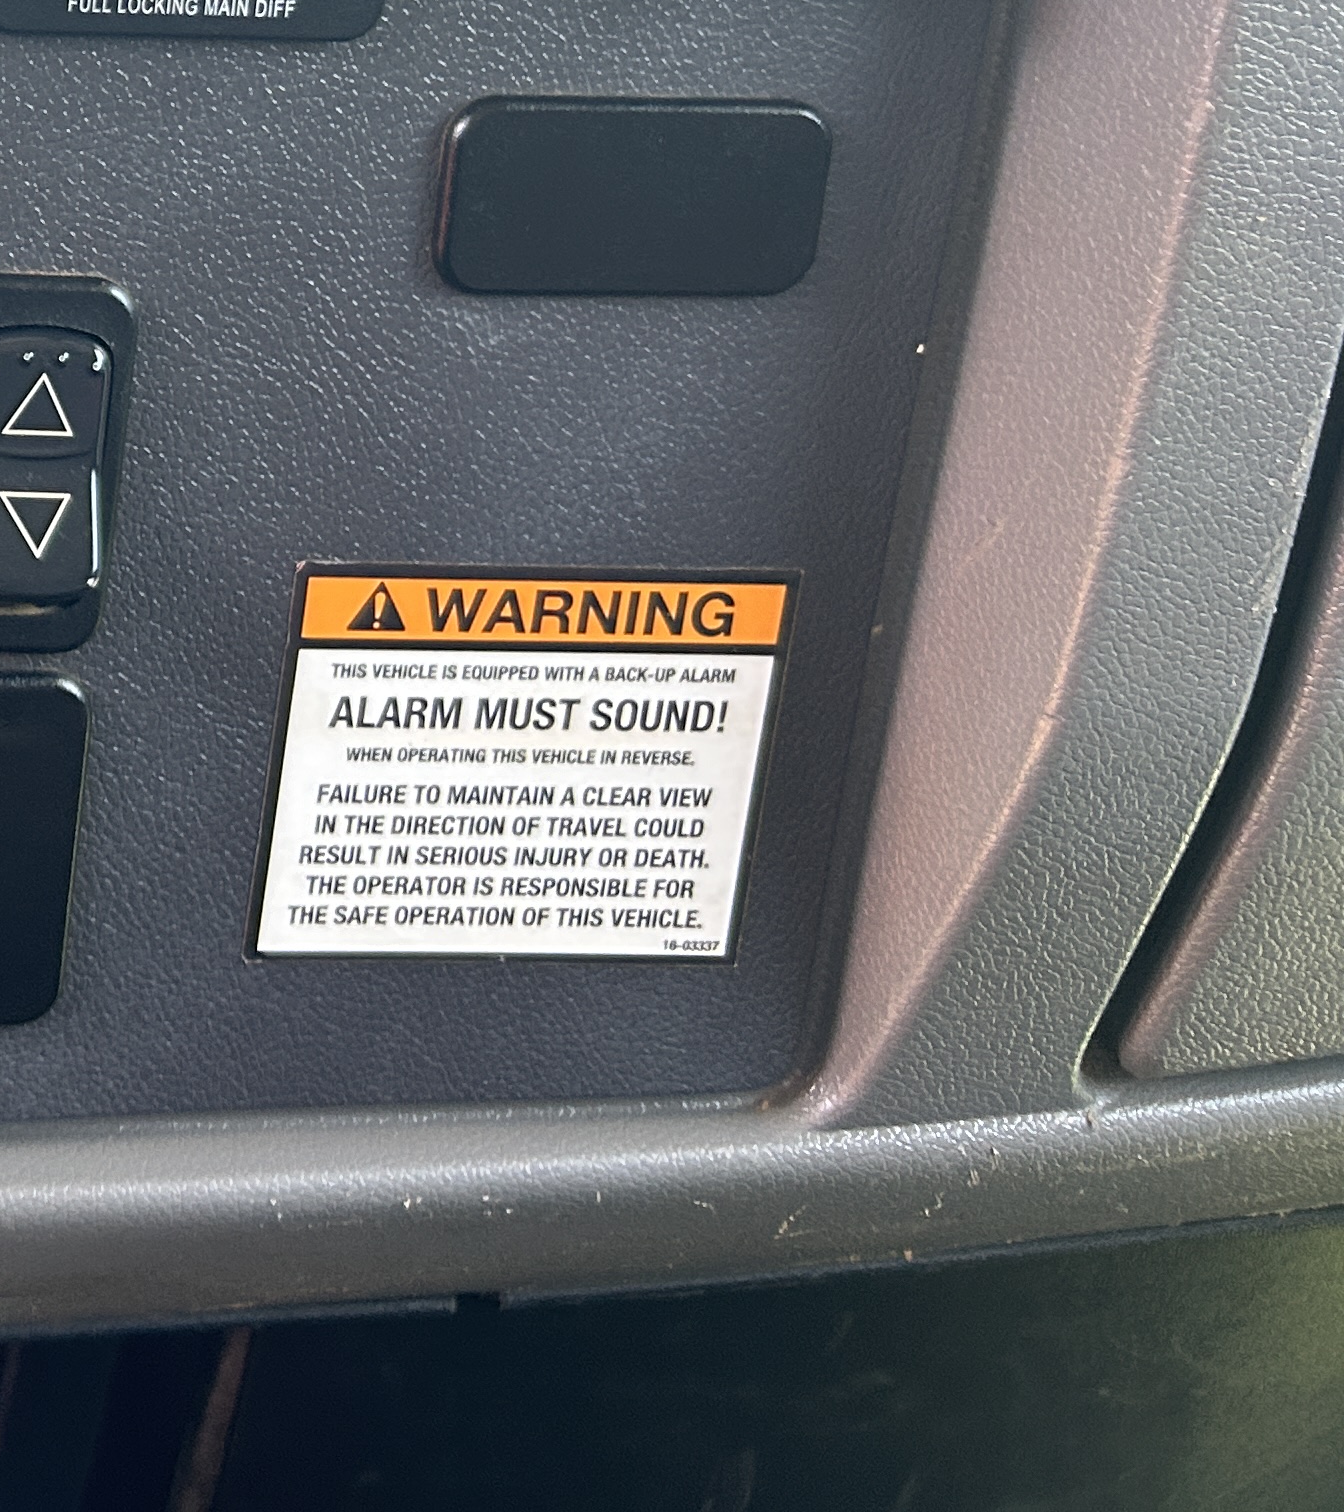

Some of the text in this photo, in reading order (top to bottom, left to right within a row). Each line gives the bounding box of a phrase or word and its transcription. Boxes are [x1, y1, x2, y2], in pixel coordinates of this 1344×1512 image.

[255, 0, 296, 18] DIFF
[426, 587, 735, 637] WARNING
[331, 663, 736, 684] THIS VEHICLE IS EQUIPPED WITH A BACK-UP ALARM
[328, 695, 729, 733] ALARM MUST SOUND!
[346, 746, 695, 766] WHEN OPERATING THIS VEHICLE IN REVERSE.
[316, 784, 713, 807] FAILURE TO MAINTAIN A CLEAR VIEW
[314, 815, 705, 838] IN THE DIRECTION OF TRAVEL COULD
[298, 845, 709, 869] RESULT IN SERIOUS INJURY OR DEATH.
[306, 875, 695, 898] THE OPERATOR IS RESPONSIBLE FOR
[287, 906, 703, 929] THE SAFE OPERATION OF THIS VEHICLE.
[662, 939, 720, 952] 16-03337
